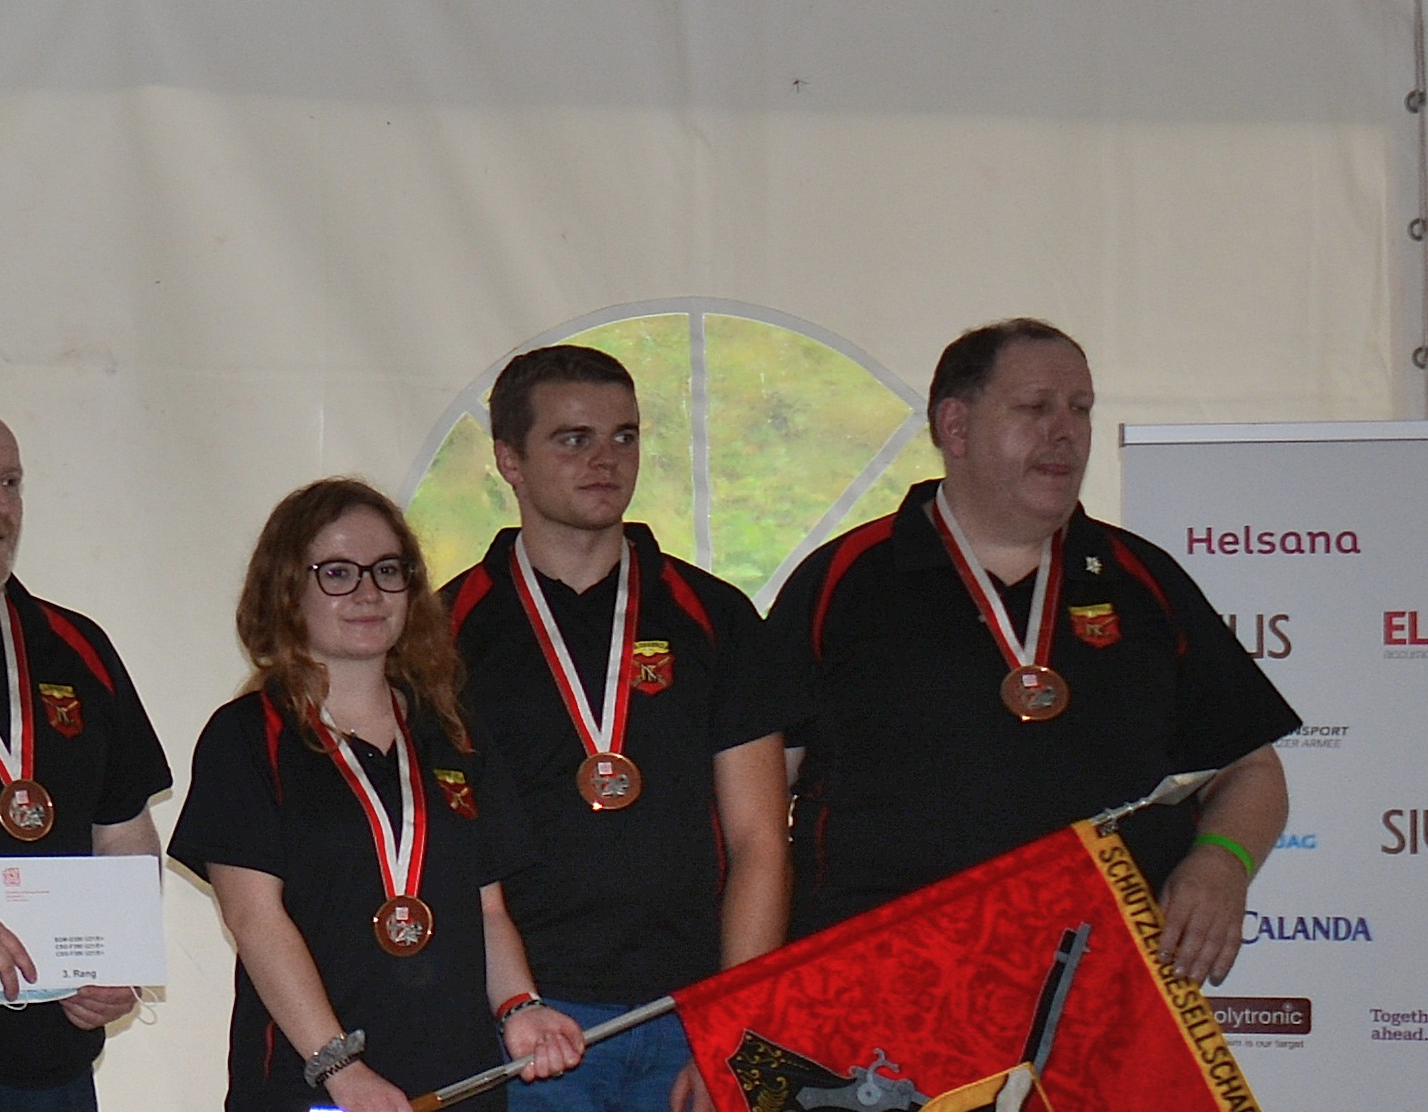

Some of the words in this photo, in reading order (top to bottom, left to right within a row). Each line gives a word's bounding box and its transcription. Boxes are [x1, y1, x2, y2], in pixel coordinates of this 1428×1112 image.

[1186, 525, 1362, 555] Helsana
[1218, 613, 1293, 660] US
[1295, 726, 1349, 736] SPORT
[1274, 834, 1317, 850] UAG
[1381, 808, 1428, 855] SI
[1214, 1003, 1303, 1029] olytronic
[1369, 1008, 1428, 1026] Togeth
